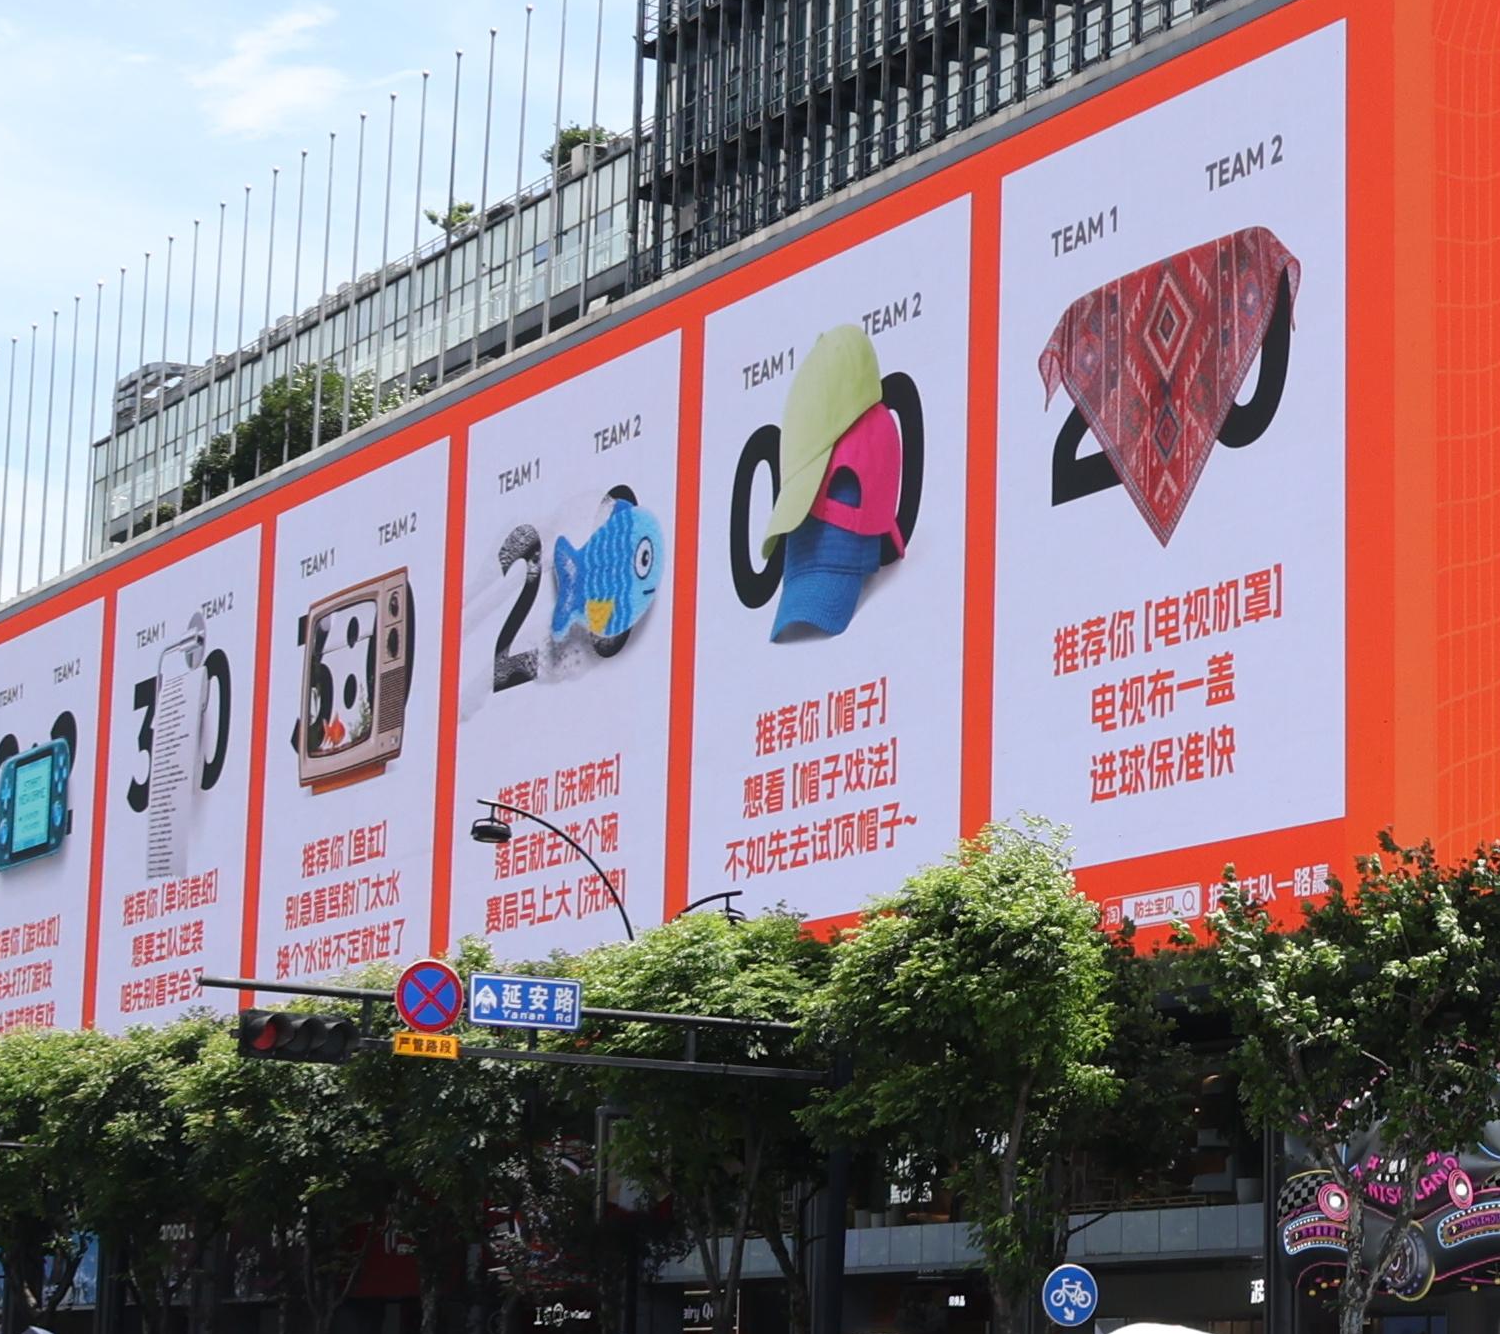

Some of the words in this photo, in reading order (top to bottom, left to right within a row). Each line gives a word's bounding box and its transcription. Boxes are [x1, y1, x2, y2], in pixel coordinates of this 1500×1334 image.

[1206, 143, 1265, 192] TEAM
[1270, 134, 1284, 168] 2
[1051, 213, 1105, 258] TEAM
[1109, 205, 1119, 233] 1
[863, 297, 908, 336] TEAM
[912, 291, 923, 317] 2
[743, 354, 786, 391] TEAM
[787, 346, 796, 370] 1
[594, 418, 631, 455] TEAM
[633, 414, 642, 438] 2
[498, 462, 532, 495] TEAM
[534, 457, 541, 480] 1
[378, 515, 408, 546] TEAM
[409, 511, 418, 533] 2
[301, 552, 328, 579] TEAM
[329, 547, 336, 568] 1
[202, 595, 226, 620] TEAM
[227, 591, 234, 611] 2
[136, 623, 159, 649] TEAM
[160, 621, 166, 640] 1
[53, 660, 75, 685] TEAM
[75, 658, 81, 676] 2
[1090, 650, 1236, 733] 电视布一盖
[1089, 723, 1236, 805] 进球保准快
[494, 811, 619, 881] 落后就去洗个碗
[502, 983, 575, 1014] 延安路
[555, 1012, 572, 1024] Rd
[398, 1037, 453, 1055] 严管路段
